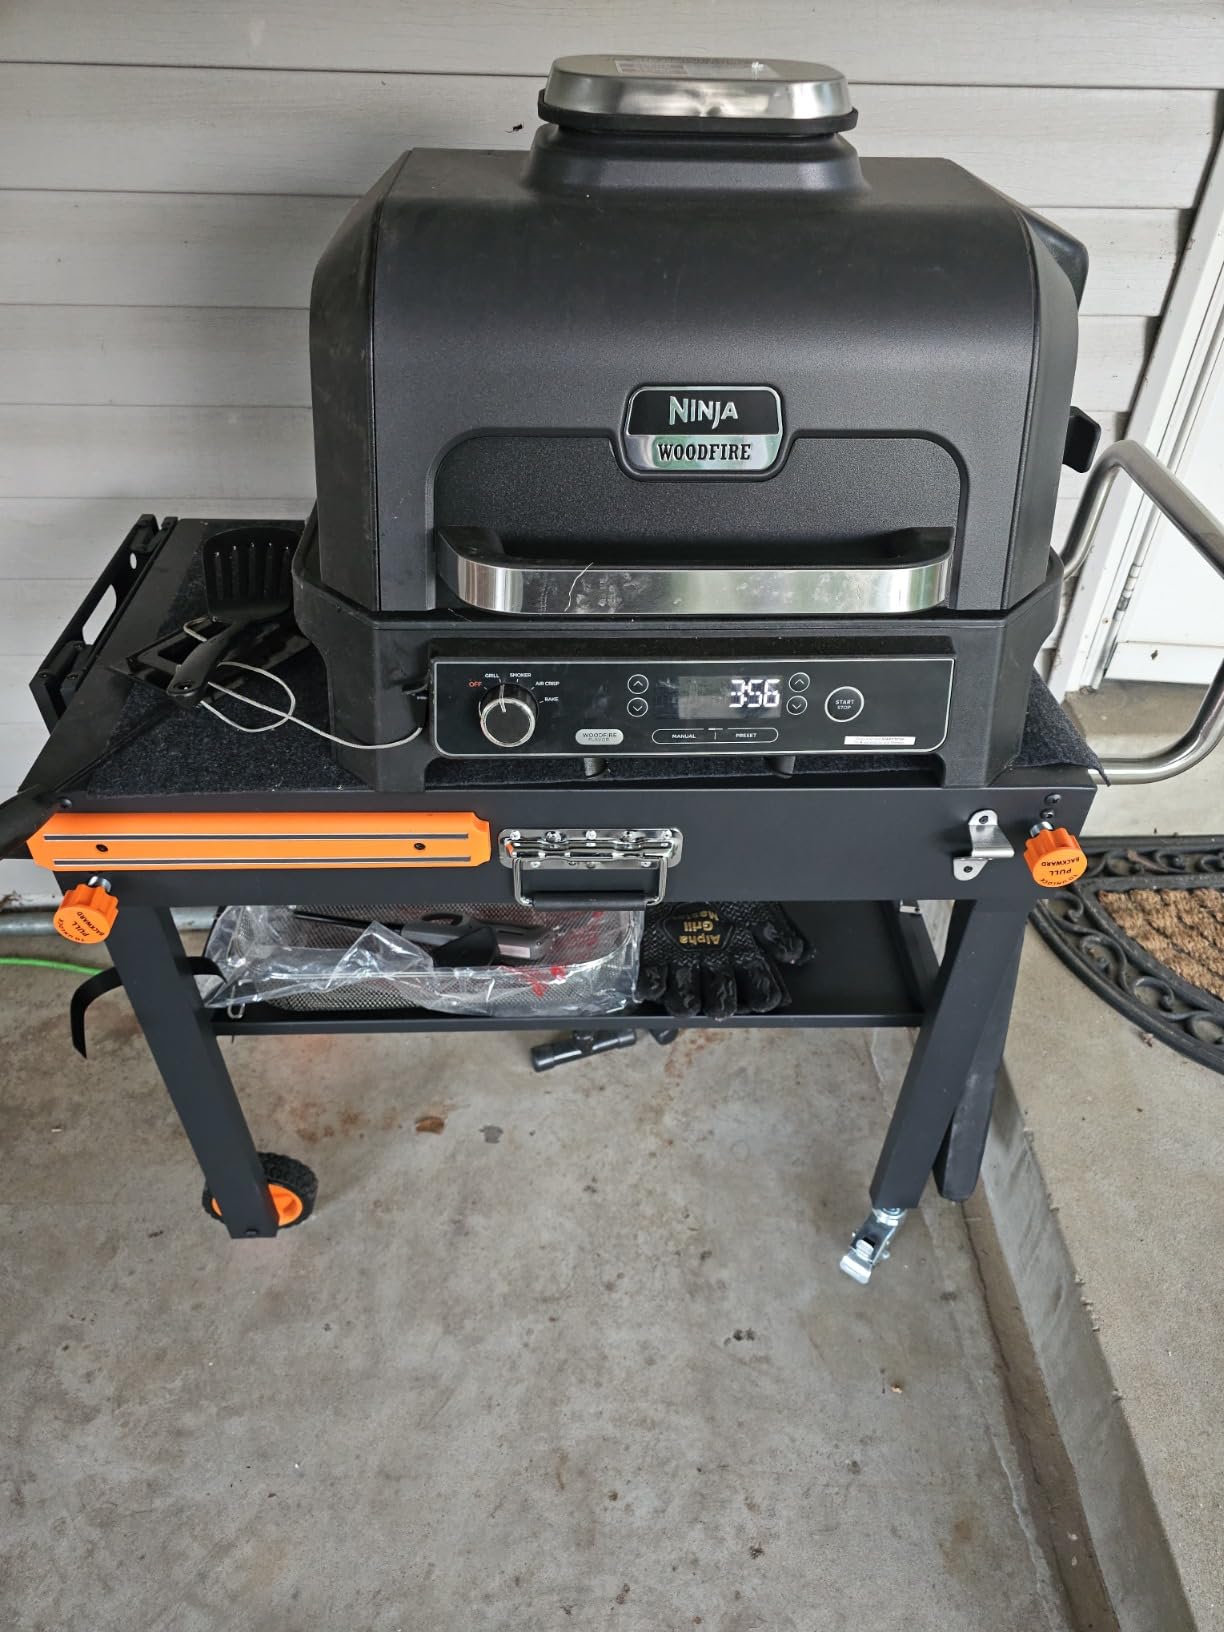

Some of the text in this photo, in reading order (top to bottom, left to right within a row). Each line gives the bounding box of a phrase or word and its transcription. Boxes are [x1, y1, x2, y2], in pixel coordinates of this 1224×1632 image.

[669, 395, 739, 430] NINJA
[657, 443, 751, 461] WOODFIRE
[1041, 856, 1080, 867] BACKWARD
[1049, 868, 1072, 876] PULL
[72, 921, 90, 937] PULL
[76, 911, 105, 936] BACKWARD
[683, 920, 714, 932] Grill
[679, 933, 721, 945] Alpha
